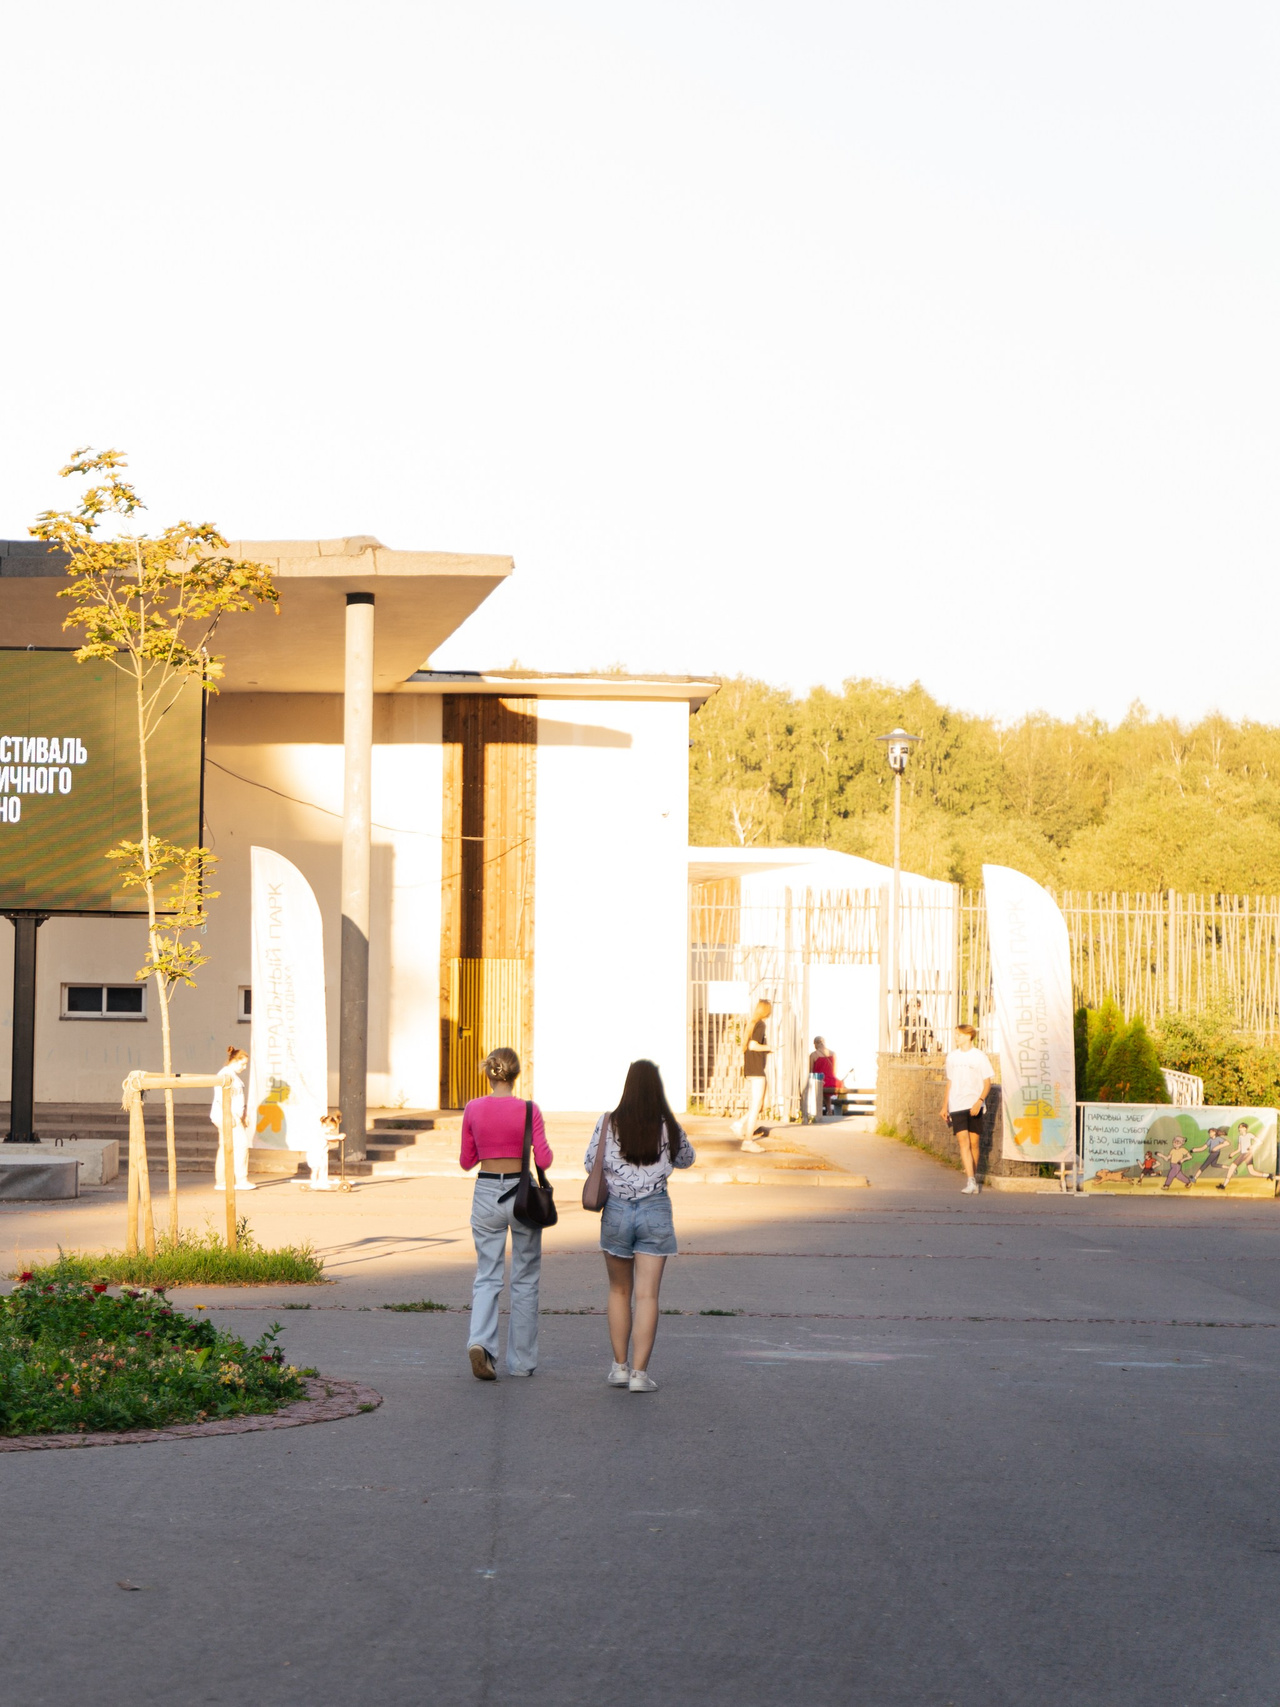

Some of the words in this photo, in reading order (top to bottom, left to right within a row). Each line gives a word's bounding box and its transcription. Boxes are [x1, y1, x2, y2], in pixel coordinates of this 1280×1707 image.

[267, 883, 284, 939] ПАРК
[1007, 898, 1029, 953] ПАРК
[1033, 978, 1048, 1033] ОТДЫХА
[1009, 962, 1040, 1117] ЦЕНТРАЛЬНЫЙ
[1039, 1050, 1052, 1117] КУЛЬТУРЫ
[1087, 1113, 1121, 1122] ПАРКОВЫЙ
[1125, 1114, 1145, 1122] ЗАБЕГ
[1122, 1127, 1150, 1135] СУББОТУ
